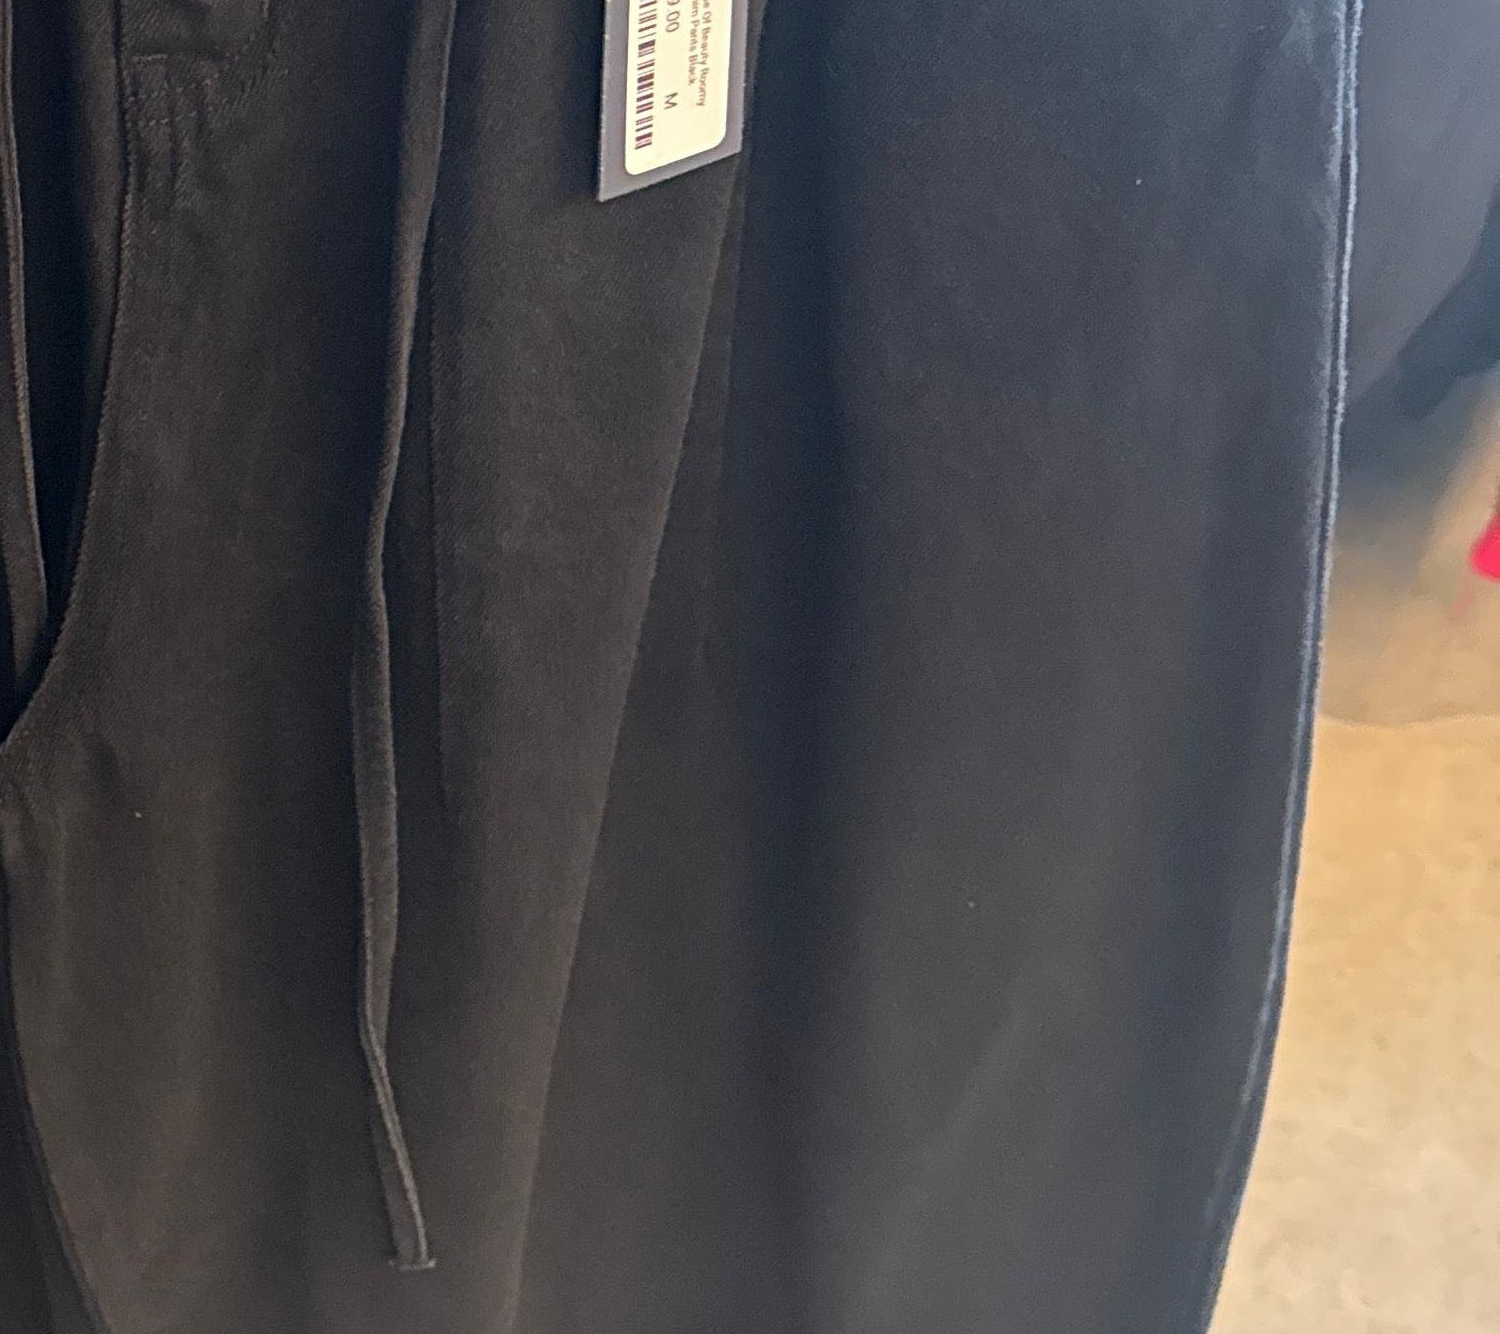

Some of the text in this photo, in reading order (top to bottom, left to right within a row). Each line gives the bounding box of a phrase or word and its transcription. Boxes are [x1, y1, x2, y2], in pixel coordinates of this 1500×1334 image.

[702, 11, 712, 24] Of
[689, 19, 700, 52] Pants
[699, 26, 711, 65] Beauty
[688, 54, 698, 86] Black
[664, 92, 678, 110] M
[696, 67, 709, 106] Roomy
